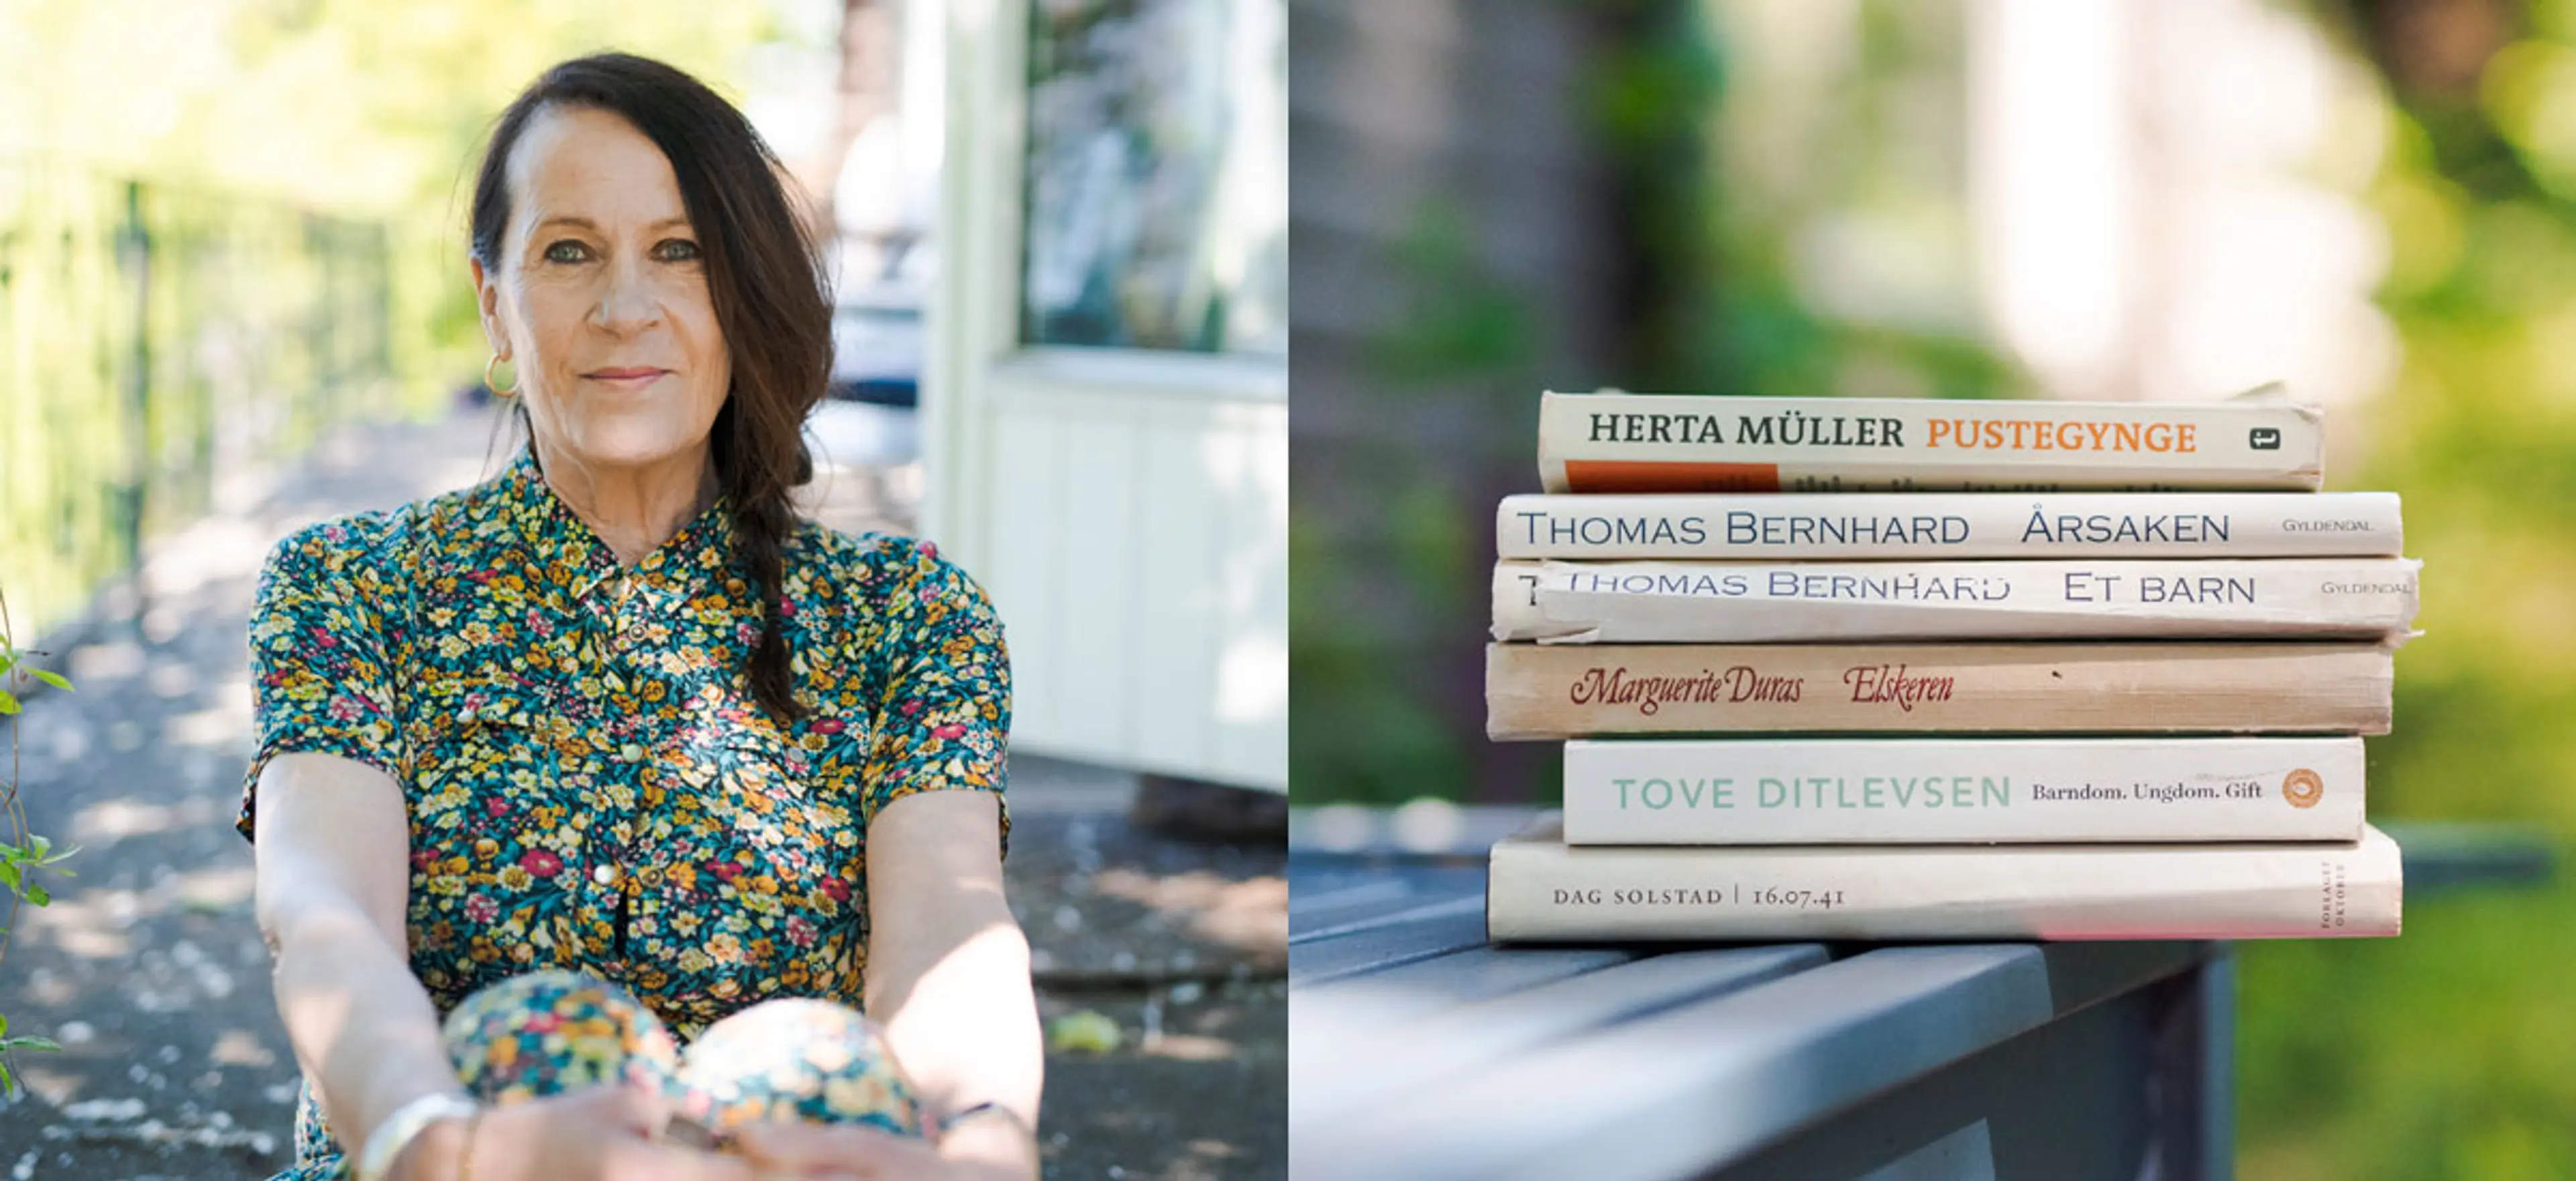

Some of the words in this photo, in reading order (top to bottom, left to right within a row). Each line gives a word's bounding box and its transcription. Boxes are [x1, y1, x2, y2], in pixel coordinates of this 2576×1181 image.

[1589, 413, 1724, 444] HERTA
[1735, 410, 1904, 448] MÜLLER
[1927, 419, 2197, 454] PUSTEGYNGE
[1517, 512, 1707, 545] THOMAS
[1726, 511, 1970, 545] BERNHARD
[2021, 503, 2229, 544] ÅRSAKEN
[2282, 519, 2374, 532] GYLDENDAL
[1768, 571, 2010, 601] BERNHARD
[2063, 572, 2121, 601] ET
[2140, 578, 2255, 604] BARN
[1570, 667, 1723, 716] Marguerite
[1725, 665, 1805, 703] Duras
[1843, 664, 1955, 712] Elskeren
[1612, 778, 1735, 809] TOVE
[1758, 776, 2010, 809] DITLEVSEN
[2032, 783, 2127, 801] Barndom.
[2133, 782, 2220, 803] Ungdom.
[2225, 781, 2263, 799] Gift
[1553, 889, 1602, 905] DAG
[1613, 889, 1723, 905] SOLSTAD
[1753, 886, 1845, 909] 16.07.41
